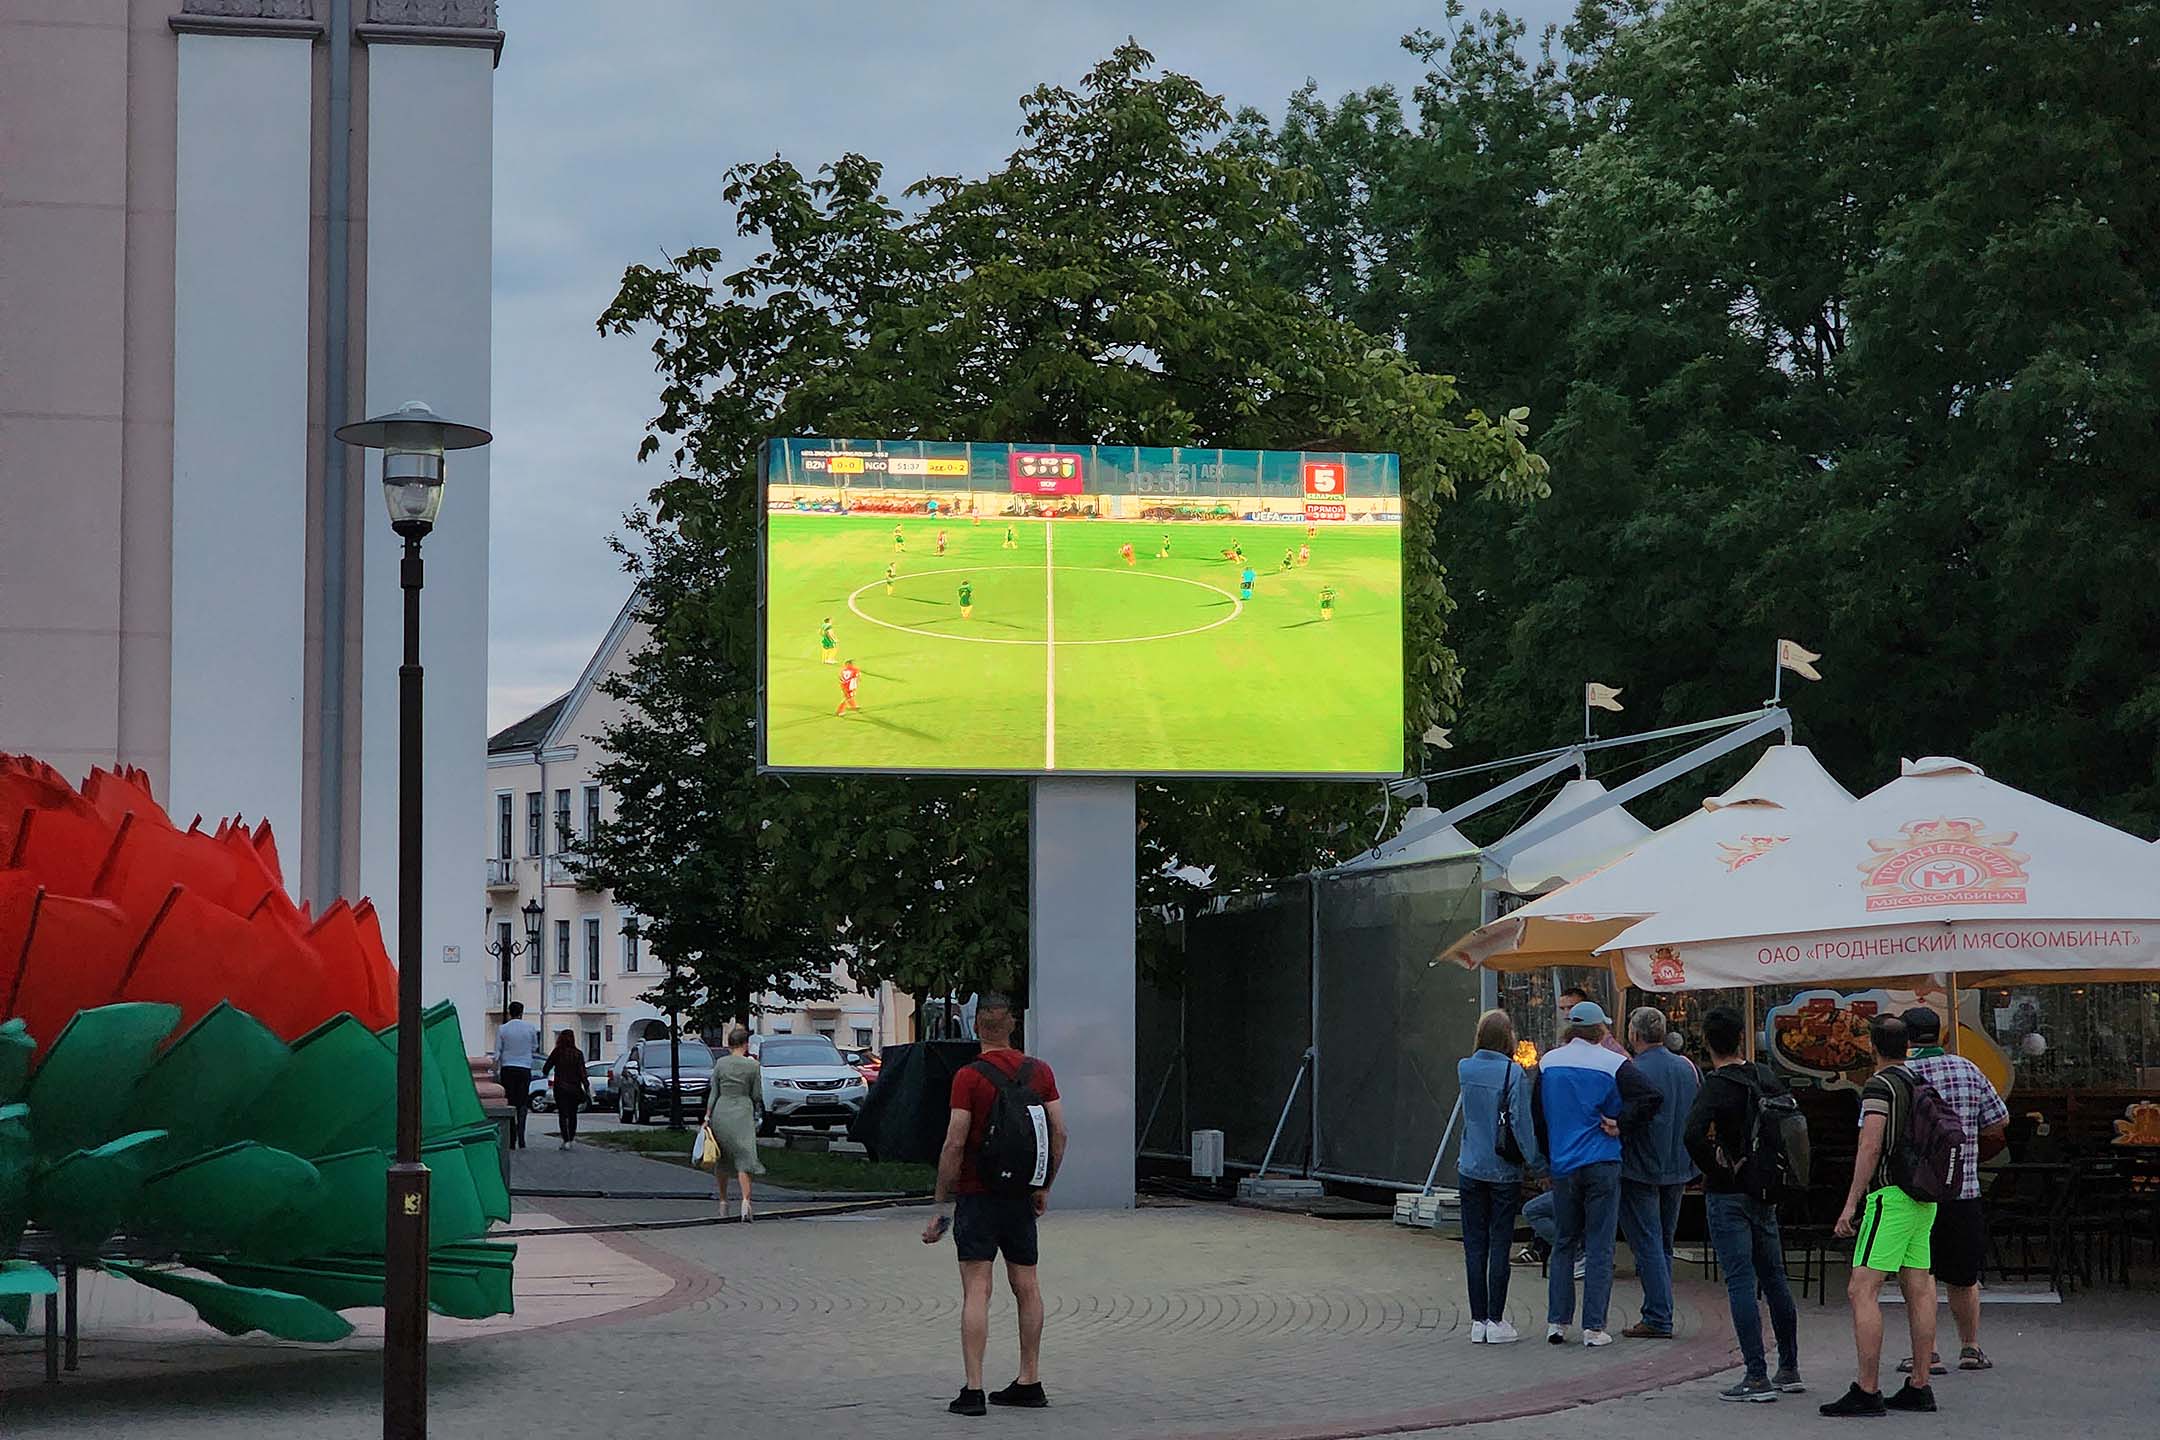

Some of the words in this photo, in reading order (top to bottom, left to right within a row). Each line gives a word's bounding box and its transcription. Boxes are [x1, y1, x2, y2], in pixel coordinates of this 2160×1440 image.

[805, 460, 826, 470] BZN
[865, 461, 888, 471] NGO
[1314, 469, 1336, 493] 5
[1307, 504, 1345, 513] ПРЯМОЙ
[1878, 843, 2014, 881] ГРОДНЕНСКИЙ
[1870, 890, 2021, 908] МЯСОКОМБИНАТ
[1758, 945, 1801, 965] ОАО
[1806, 932, 1957, 961] «ГРОДНЕНСКИЙ
[1963, 930, 2142, 950] МЯСОКОМБИНАТ»
